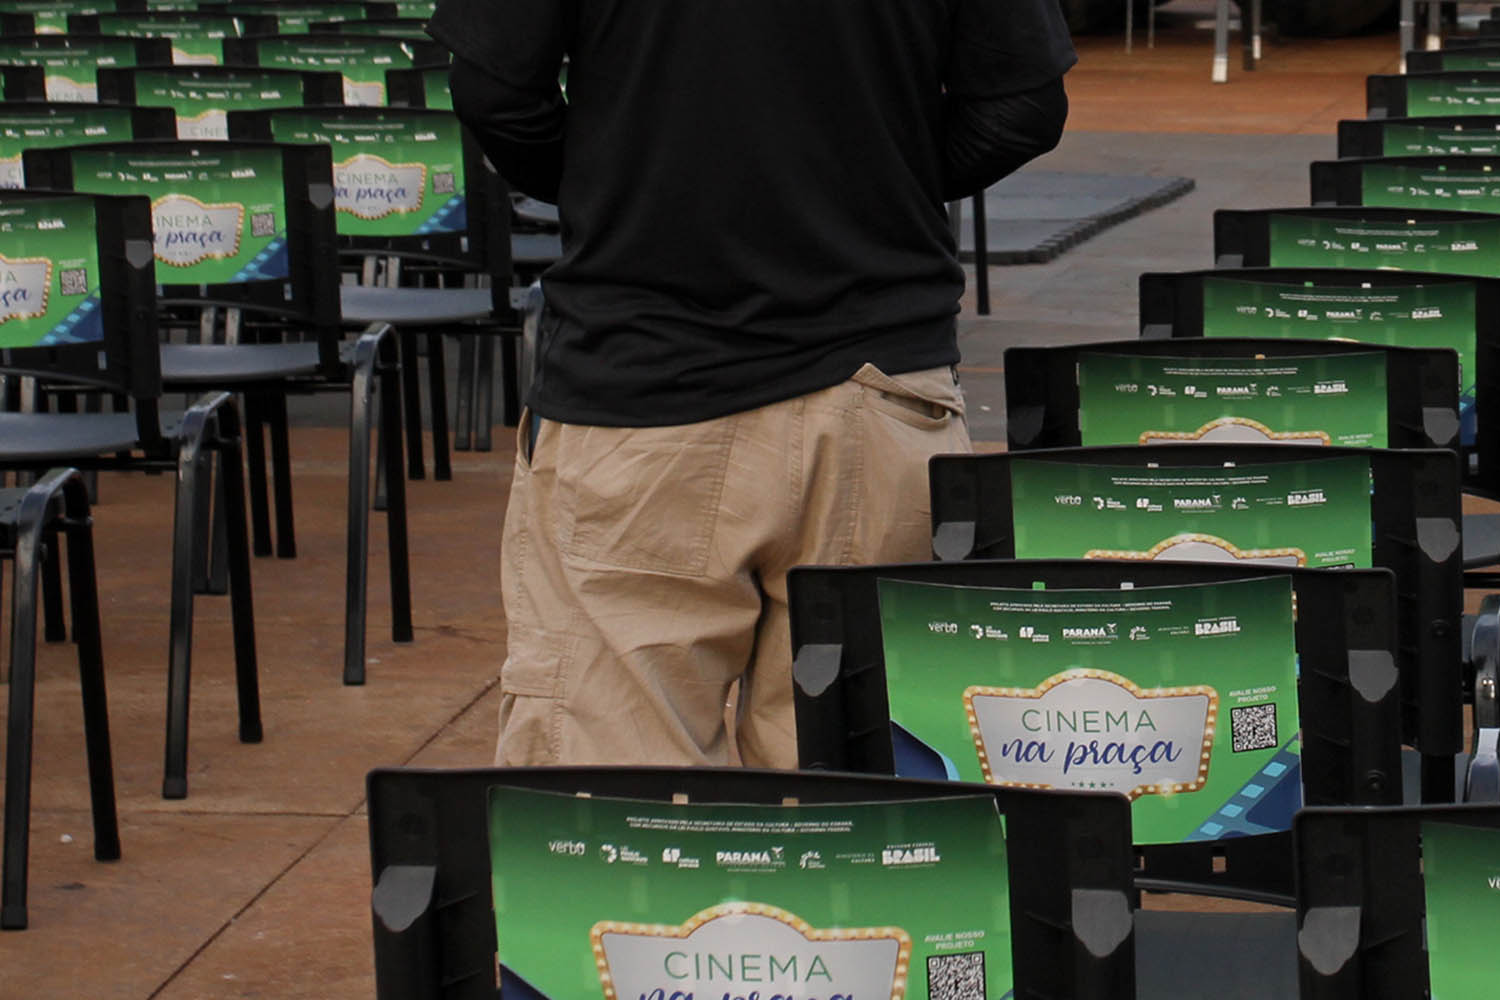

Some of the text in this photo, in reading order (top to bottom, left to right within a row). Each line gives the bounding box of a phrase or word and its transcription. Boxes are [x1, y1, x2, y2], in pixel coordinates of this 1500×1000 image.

[336, 172, 399, 184] CINEMA
[355, 187, 408, 203] praça
[155, 215, 214, 227] INEMA
[165, 230, 224, 249] praça
[1063, 625, 1106, 637] PARANÁ
[1195, 620, 1241, 635] BRASIL
[1021, 709, 1157, 733] CINEMA
[1002, 737, 1183, 774] na praça
[549, 841, 585, 856] verbo
[716, 850, 771, 863] PARANÁ
[882, 847, 940, 865] BRASIL
[959, 931, 985, 941] NOSSO
[936, 940, 975, 951] PROJETO
[664, 952, 833, 983] CINEMA
